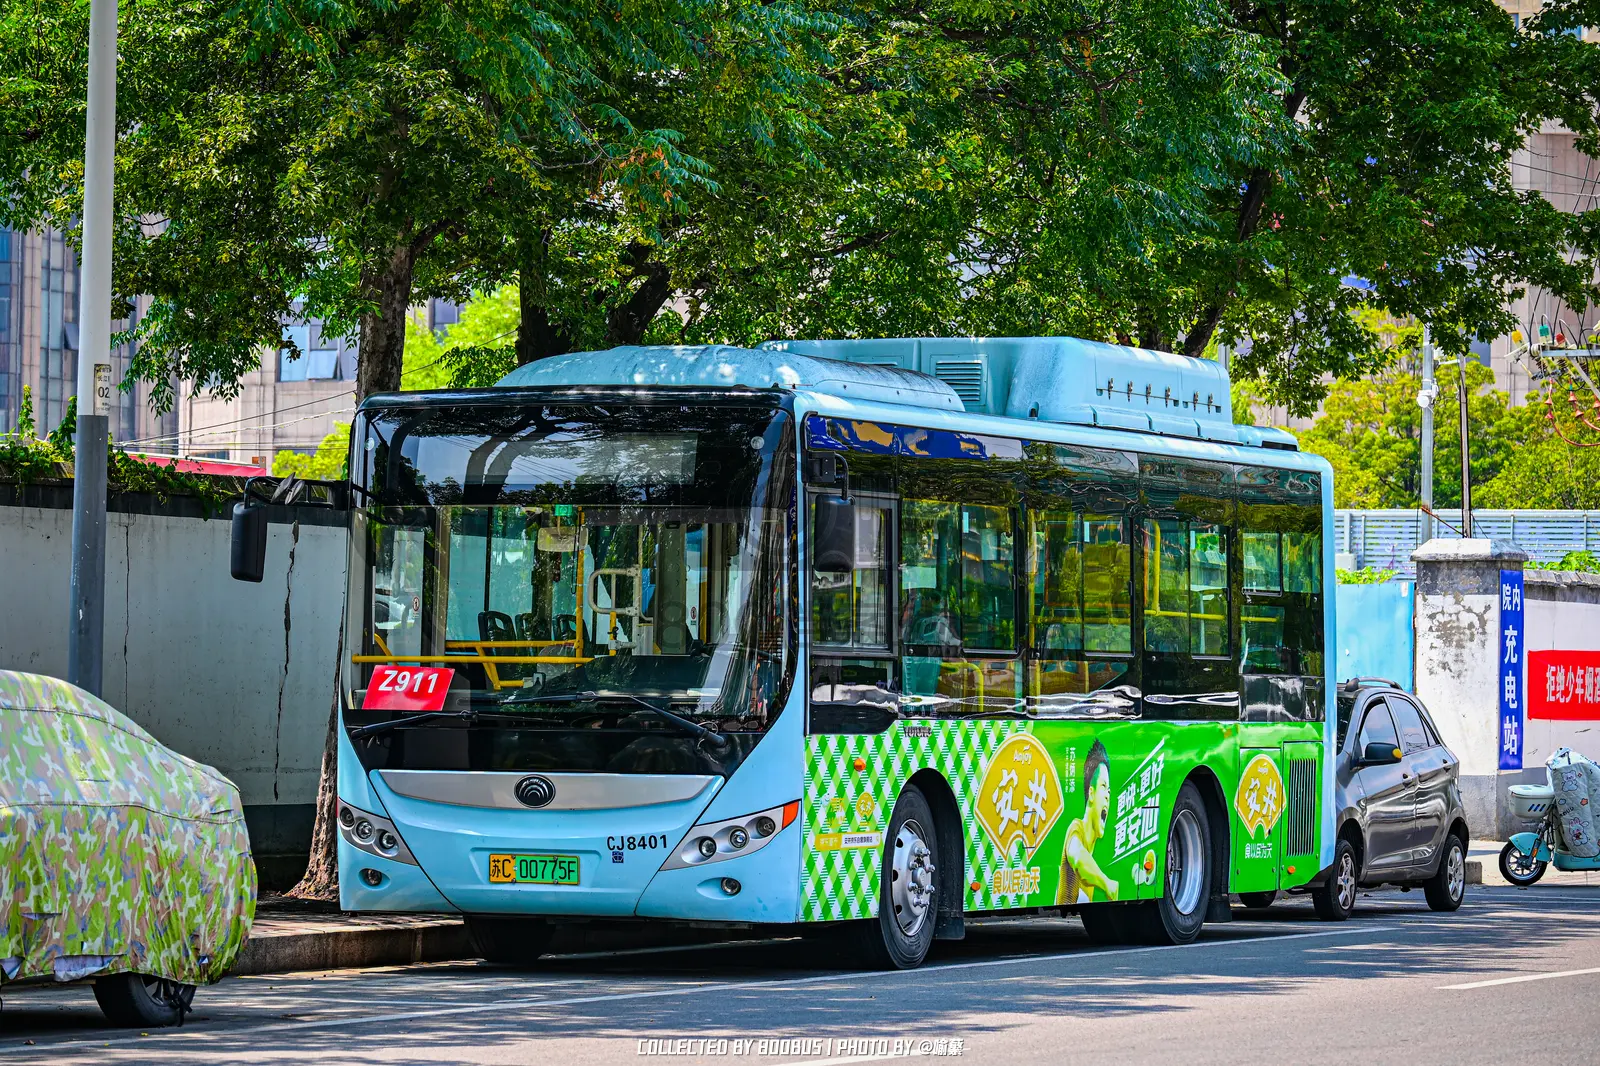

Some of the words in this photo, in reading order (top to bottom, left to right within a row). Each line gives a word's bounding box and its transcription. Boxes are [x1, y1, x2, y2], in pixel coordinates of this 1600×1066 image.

[98, 387, 110, 398] 02
[1502, 583, 1520, 612] 院内
[378, 669, 438, 693] Z911
[1503, 624, 1518, 755] 充电站
[1013, 748, 1032, 765] Anjoy
[992, 768, 1047, 838] 安井
[1245, 777, 1277, 822] 安井
[1112, 793, 1160, 860] 更安心
[607, 835, 667, 850] CJ8401
[993, 867, 1040, 895] 食以民为天
